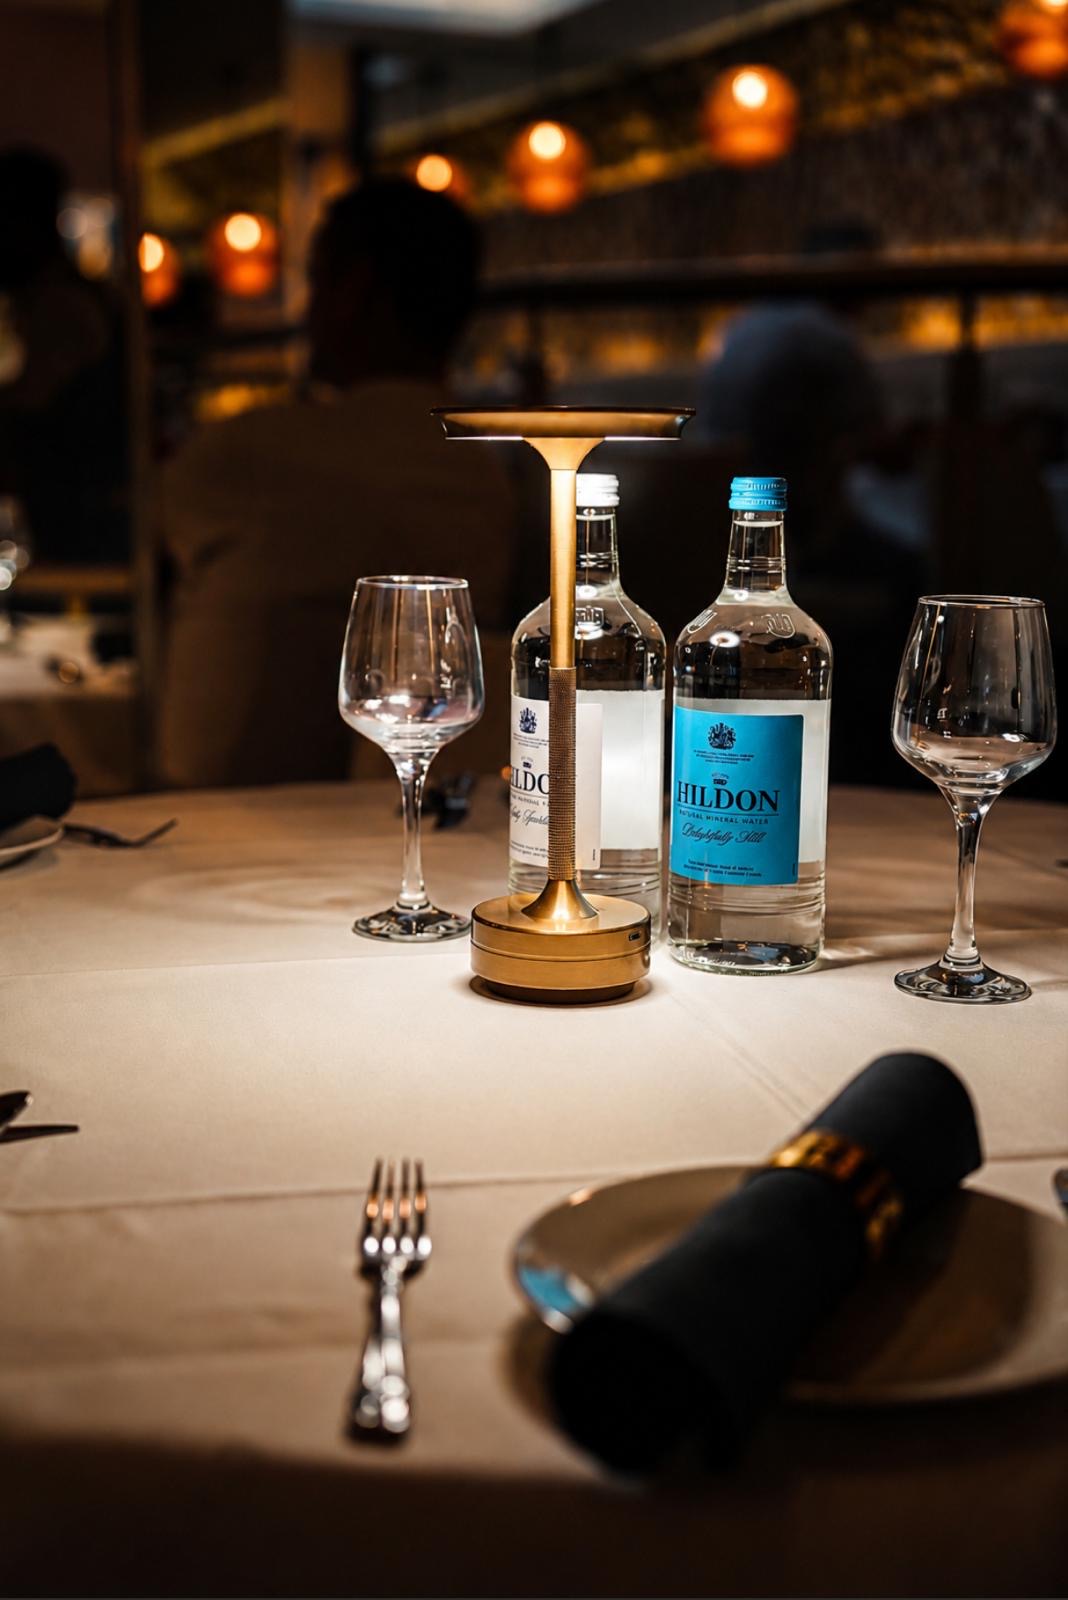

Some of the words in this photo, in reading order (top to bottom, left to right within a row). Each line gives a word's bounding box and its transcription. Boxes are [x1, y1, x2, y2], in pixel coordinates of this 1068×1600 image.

[511, 767, 549, 795] ILDO
[677, 781, 780, 812] HILDON
[679, 808, 703, 820] NATURAL
[706, 815, 738, 824] MINERAL
